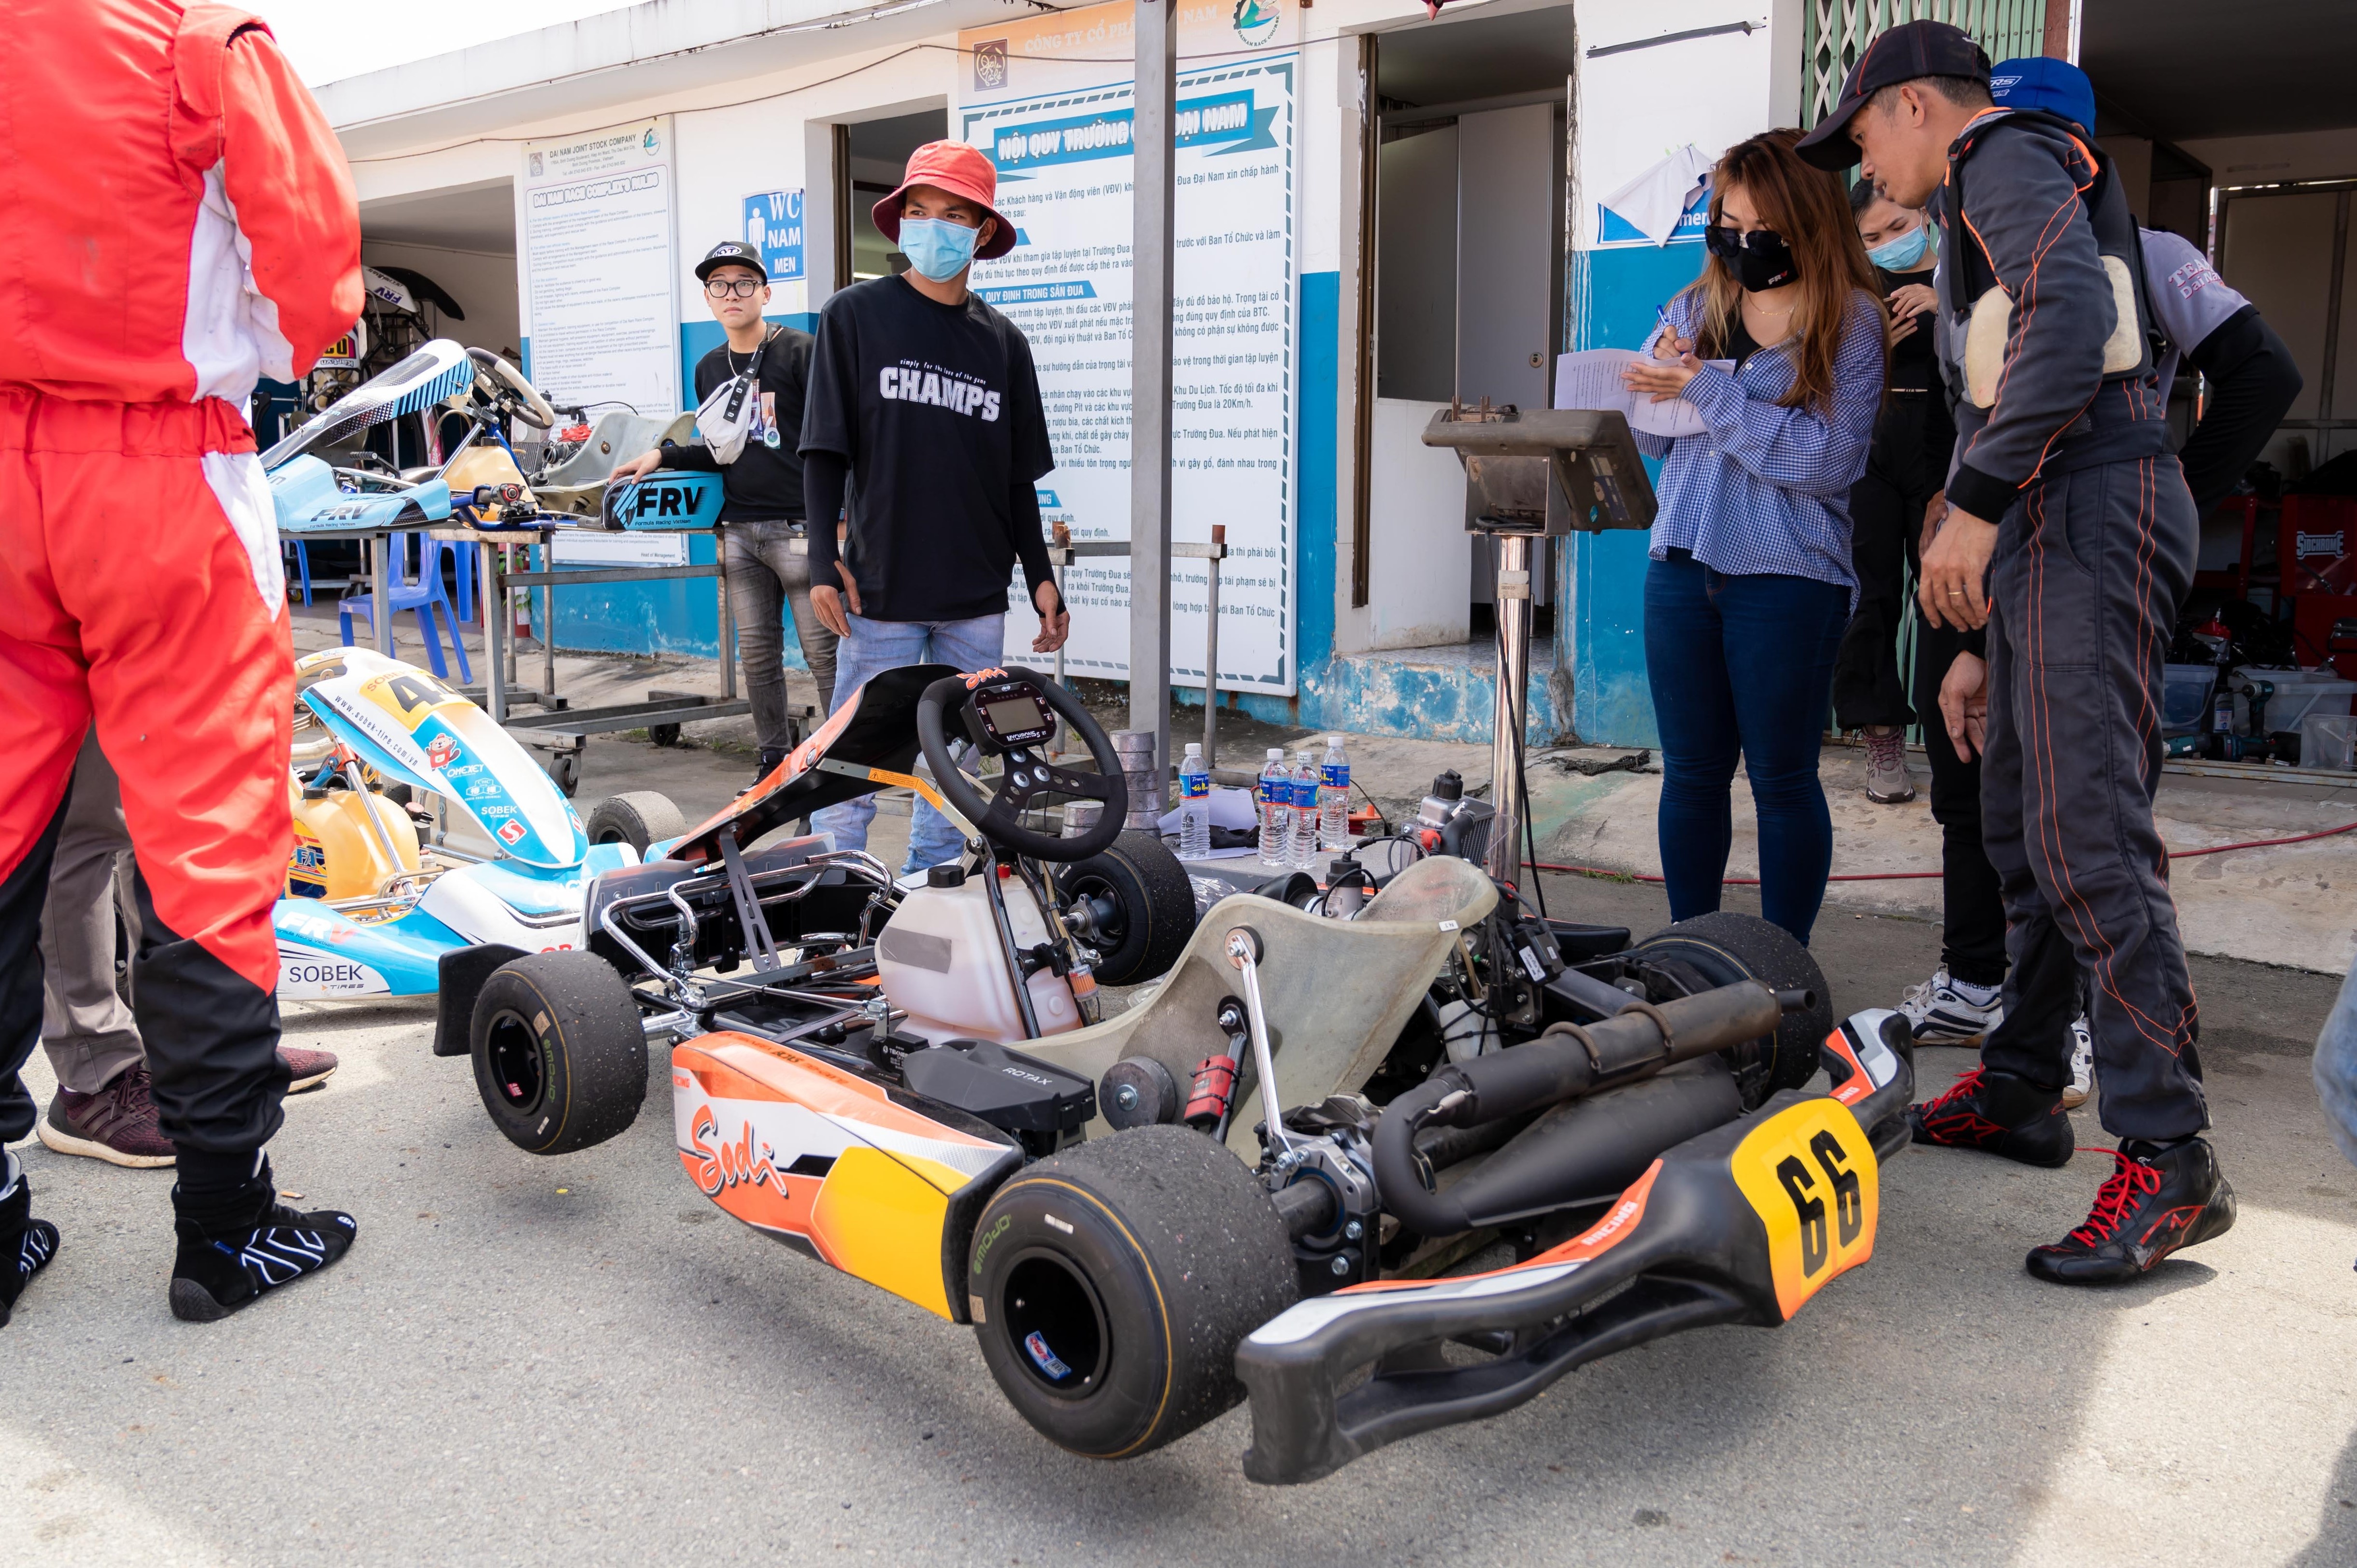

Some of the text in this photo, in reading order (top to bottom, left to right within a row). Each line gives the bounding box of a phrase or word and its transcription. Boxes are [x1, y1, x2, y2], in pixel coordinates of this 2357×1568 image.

[1025, 33, 1062, 53] CÔNG
[1065, 31, 1083, 44] TY
[1184, 6, 1217, 22] NAM
[998, 128, 1027, 164] NỘI
[1029, 129, 1060, 156] QUY
[1063, 119, 1128, 149] TRƯỜNG
[1203, 102, 1247, 132] NAM
[550, 134, 636, 158] DAI NAM JOINT STOCK COMPANY
[769, 193, 800, 221] WC
[769, 227, 800, 248] NAM
[774, 257, 795, 273] MEN
[1768, 271, 1787, 285] FRV
[374, 286, 402, 304] FRV
[986, 285, 1084, 303] QUY ĐỊNH TRONG SÂN ĐUA
[900, 359, 919, 369] simply
[944, 368, 953, 376] love
[974, 377, 986, 385] game
[880, 367, 1000, 422] CHAMPS
[636, 486, 710, 517] FRV
[311, 505, 370, 522] FRV
[2297, 534, 2343, 556] SIDCHROME
[335, 696, 418, 766] www.sobek-tire.com/vn
[447, 764, 484, 778] OMEXEY
[481, 805, 518, 815] SOBEK
[296, 848, 316, 868] FA
[276, 912, 358, 944] FRV
[296, 933, 313, 942] Racing
[314, 939, 334, 948] VietNam
[289, 964, 364, 983] SOBEK
[1002, 1067, 1053, 1085] ROTAX
[691, 1104, 789, 1199] Sodi
[1776, 1129, 1862, 1279] 66
[1581, 1200, 1638, 1246] RACING
[976, 1214, 1010, 1263] MOJO
